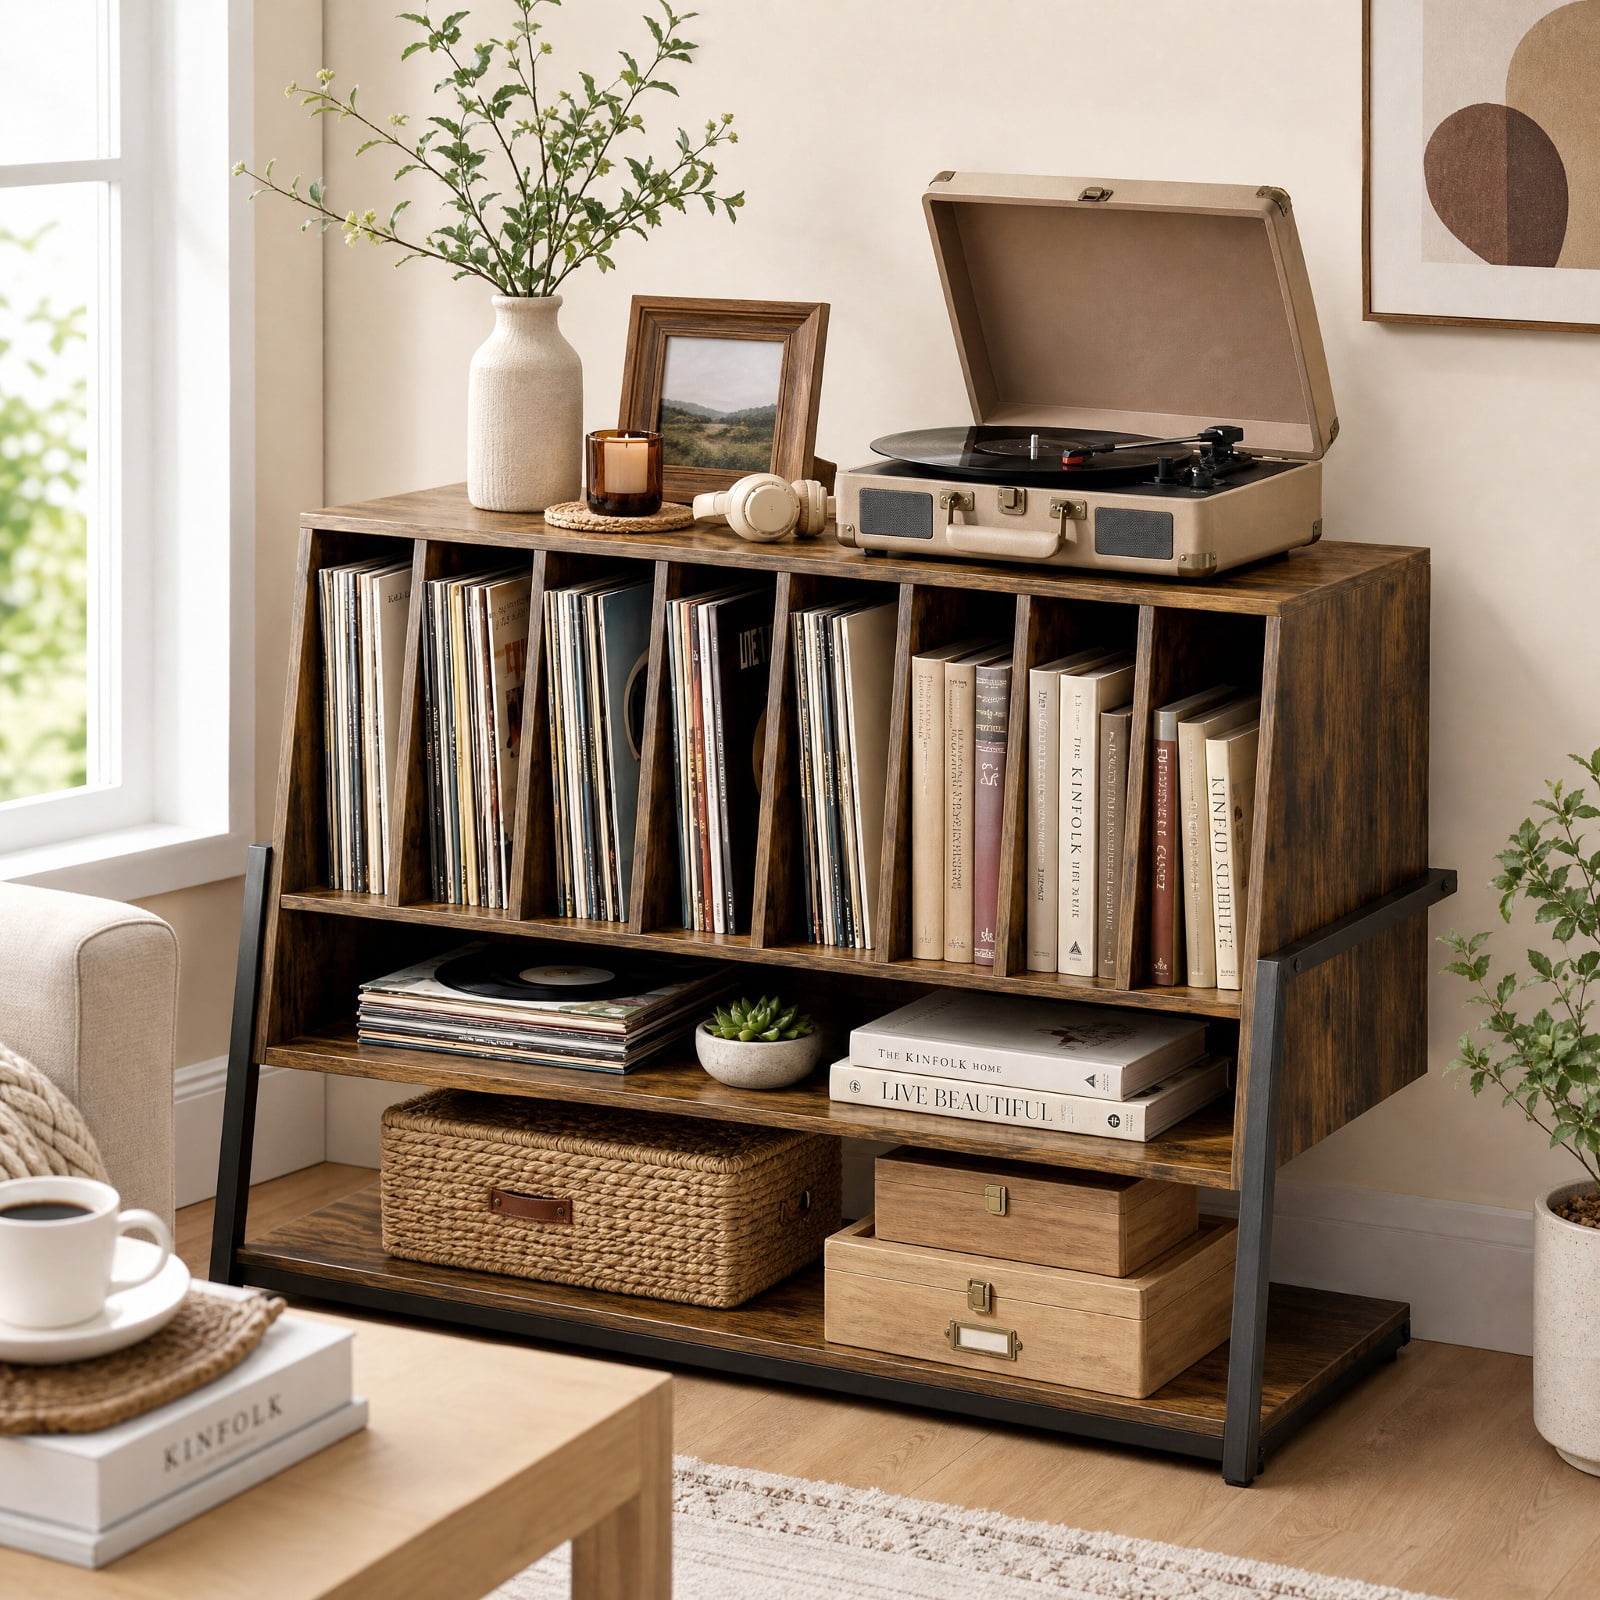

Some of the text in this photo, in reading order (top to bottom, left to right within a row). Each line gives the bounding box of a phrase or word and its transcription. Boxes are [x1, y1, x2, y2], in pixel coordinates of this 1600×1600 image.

[1071, 767, 1083, 855] KINFOLK
[878, 1048, 1002, 1074] THE KINFOLK HOME
[881, 1081, 928, 1106] LIVE
[934, 1087, 1053, 1122] BEAUTIFUL
[163, 1393, 283, 1474] KINFOLK
